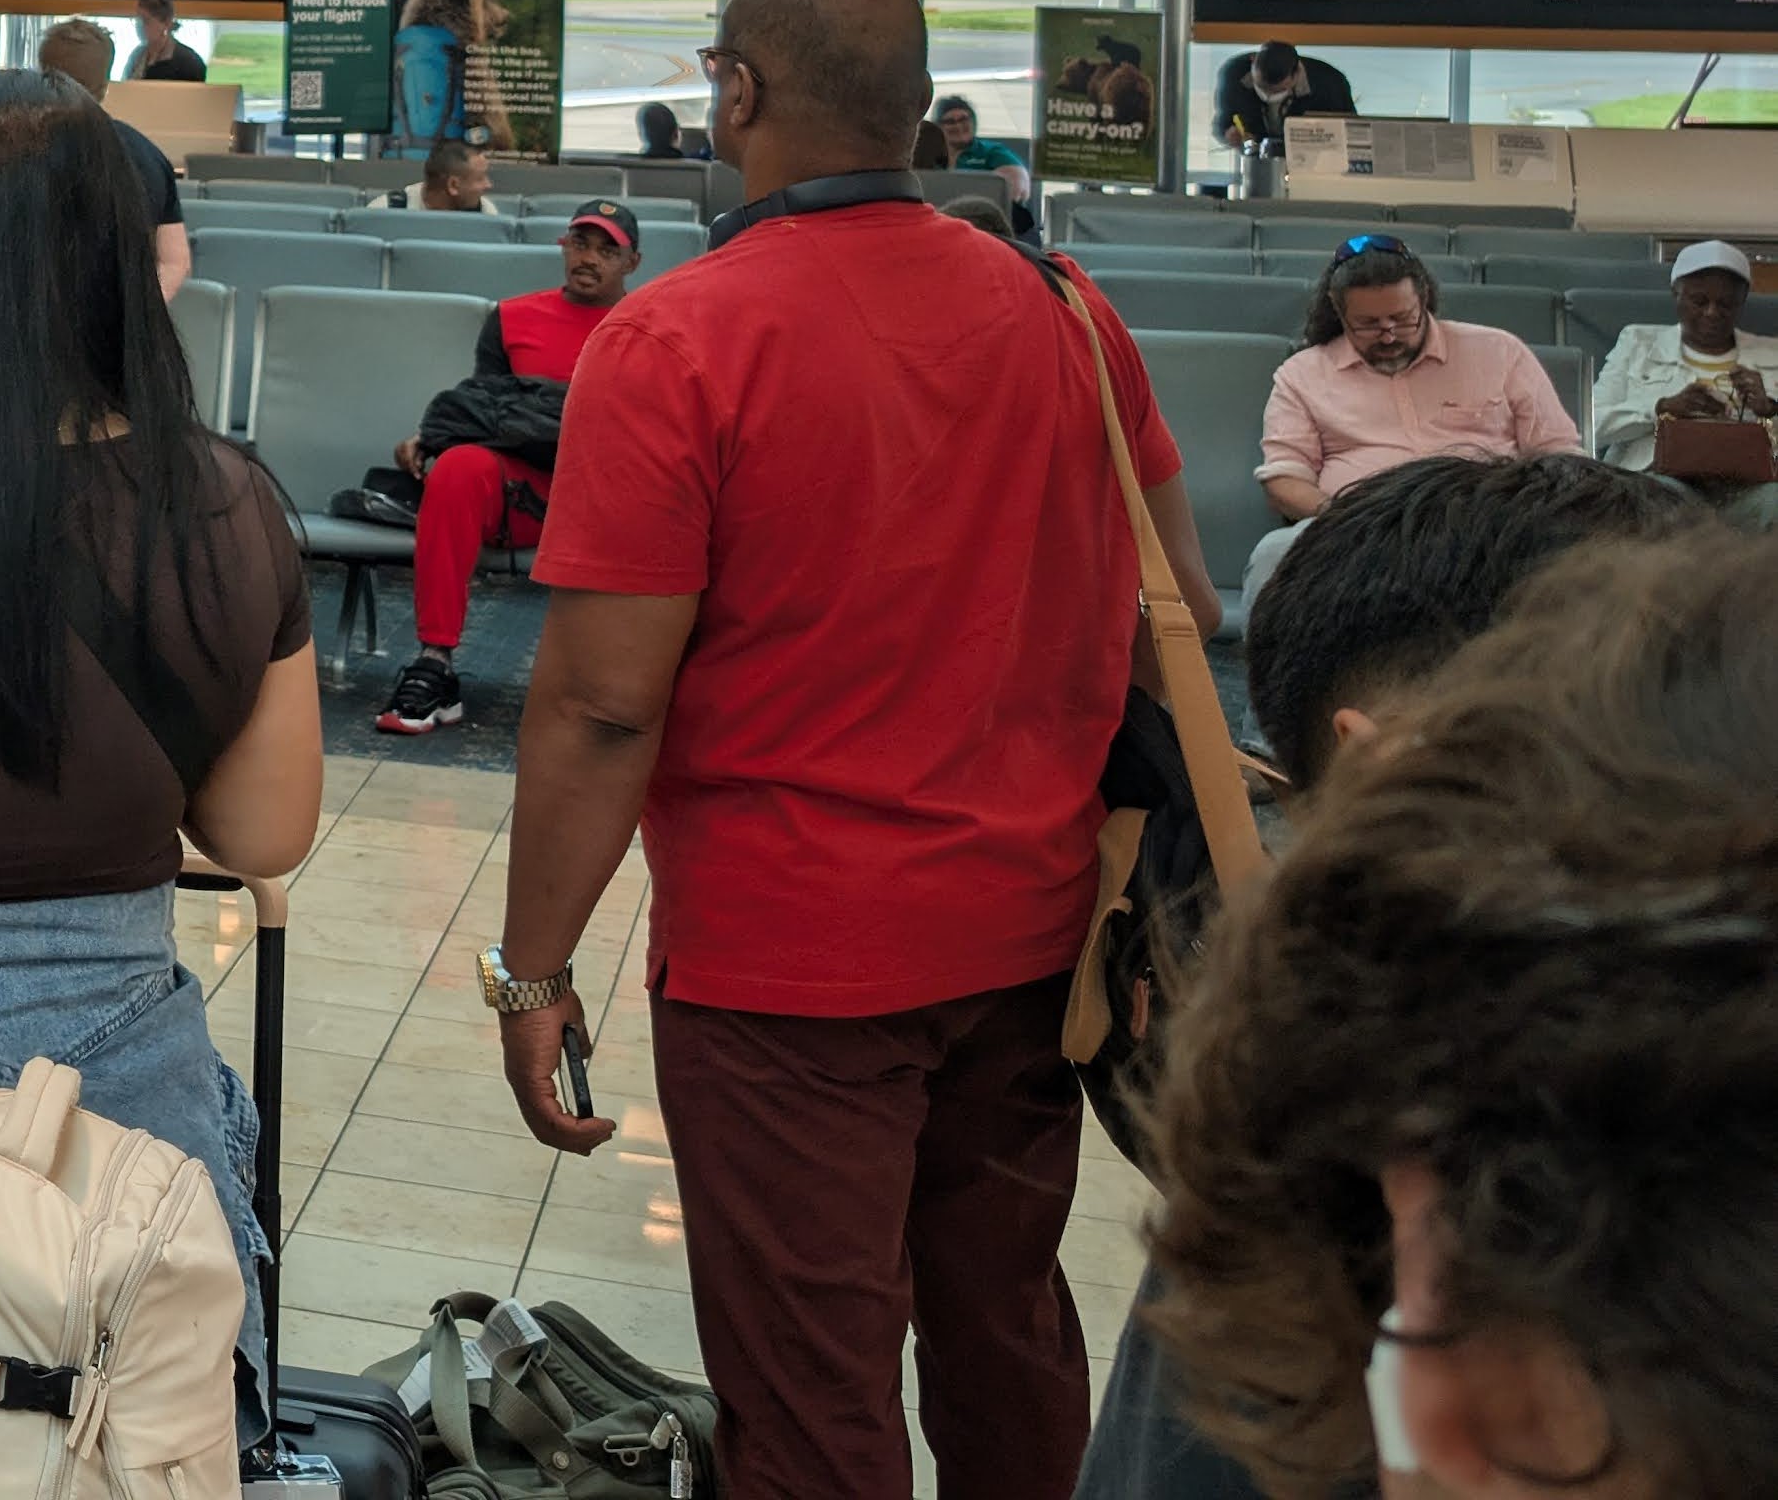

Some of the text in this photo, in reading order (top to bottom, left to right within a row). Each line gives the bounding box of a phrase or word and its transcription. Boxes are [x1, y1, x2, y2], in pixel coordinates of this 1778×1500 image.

[292, 9, 364, 24] your flight?
[1047, 98, 1114, 118] Have a
[1047, 120, 1144, 140] carry-on?
